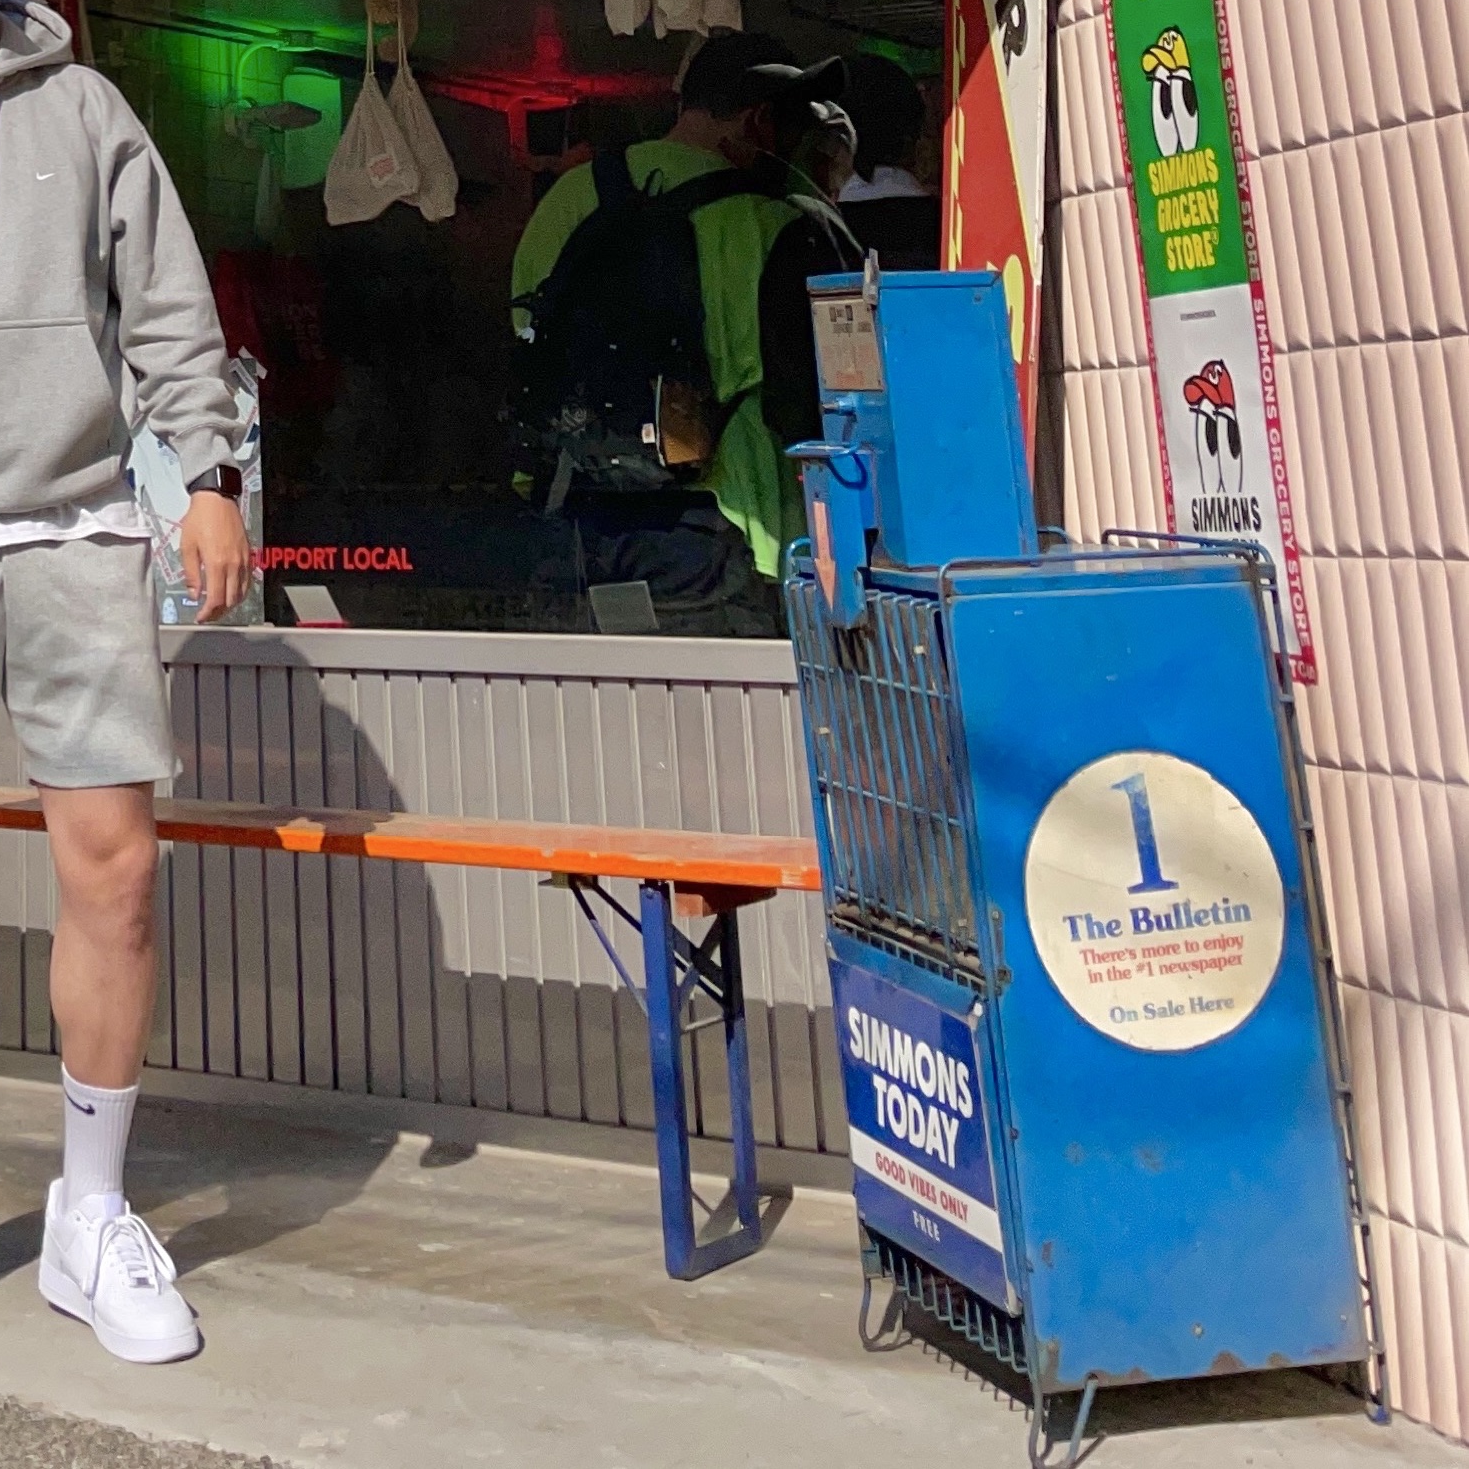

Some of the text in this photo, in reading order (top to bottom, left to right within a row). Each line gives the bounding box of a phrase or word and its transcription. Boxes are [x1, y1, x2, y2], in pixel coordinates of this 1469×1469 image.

[1148, 148, 1219, 196] SIMMONS
[1224, 76, 1250, 194] GROCERY
[1241, 201, 1261, 280] STORE
[1157, 188, 1220, 233] GROCERY
[1253, 298, 1278, 419] SIMMONS
[1268, 428, 1296, 551] GROCERY
[1287, 560, 1311, 648] STORE
[1191, 496, 1262, 533] SIMMONS
[342, 546, 414, 571] LOCAL
[1110, 772, 1180, 896] 1
[1062, 897, 1253, 943] The Bulletin
[1080, 933, 1245, 967] There's more to enjoy
[1088, 953, 1244, 984] in the #1 newspaper
[1109, 995, 1236, 1025] On Sale Here
[848, 1005, 974, 1119] SIMMONS
[872, 1072, 960, 1169] TODAY
[875, 1151, 969, 1223] GOOD VIBES ONLY
[912, 1210, 942, 1242] FREE
